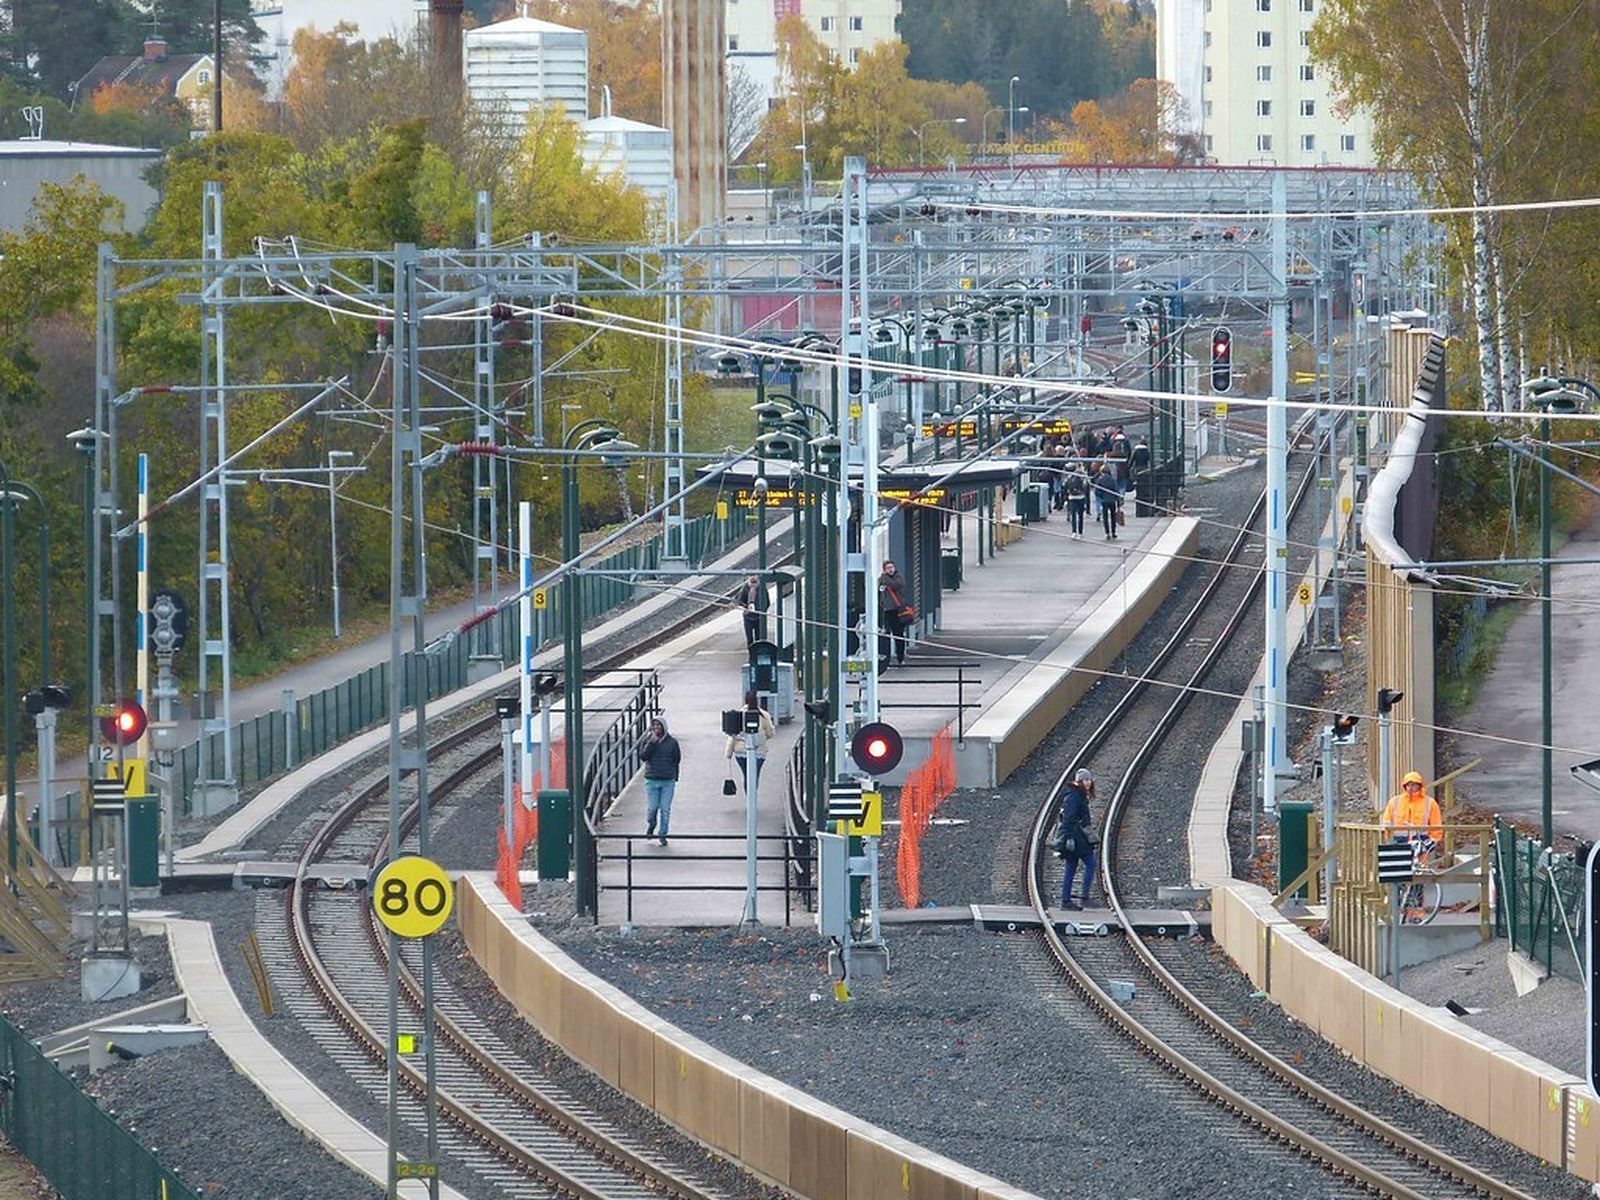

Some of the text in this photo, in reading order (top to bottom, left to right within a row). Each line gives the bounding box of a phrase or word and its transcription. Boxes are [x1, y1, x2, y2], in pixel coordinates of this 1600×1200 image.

[535, 593, 544, 604] 3
[1300, 588, 1309, 600] 3
[380, 878, 446, 917] 80
